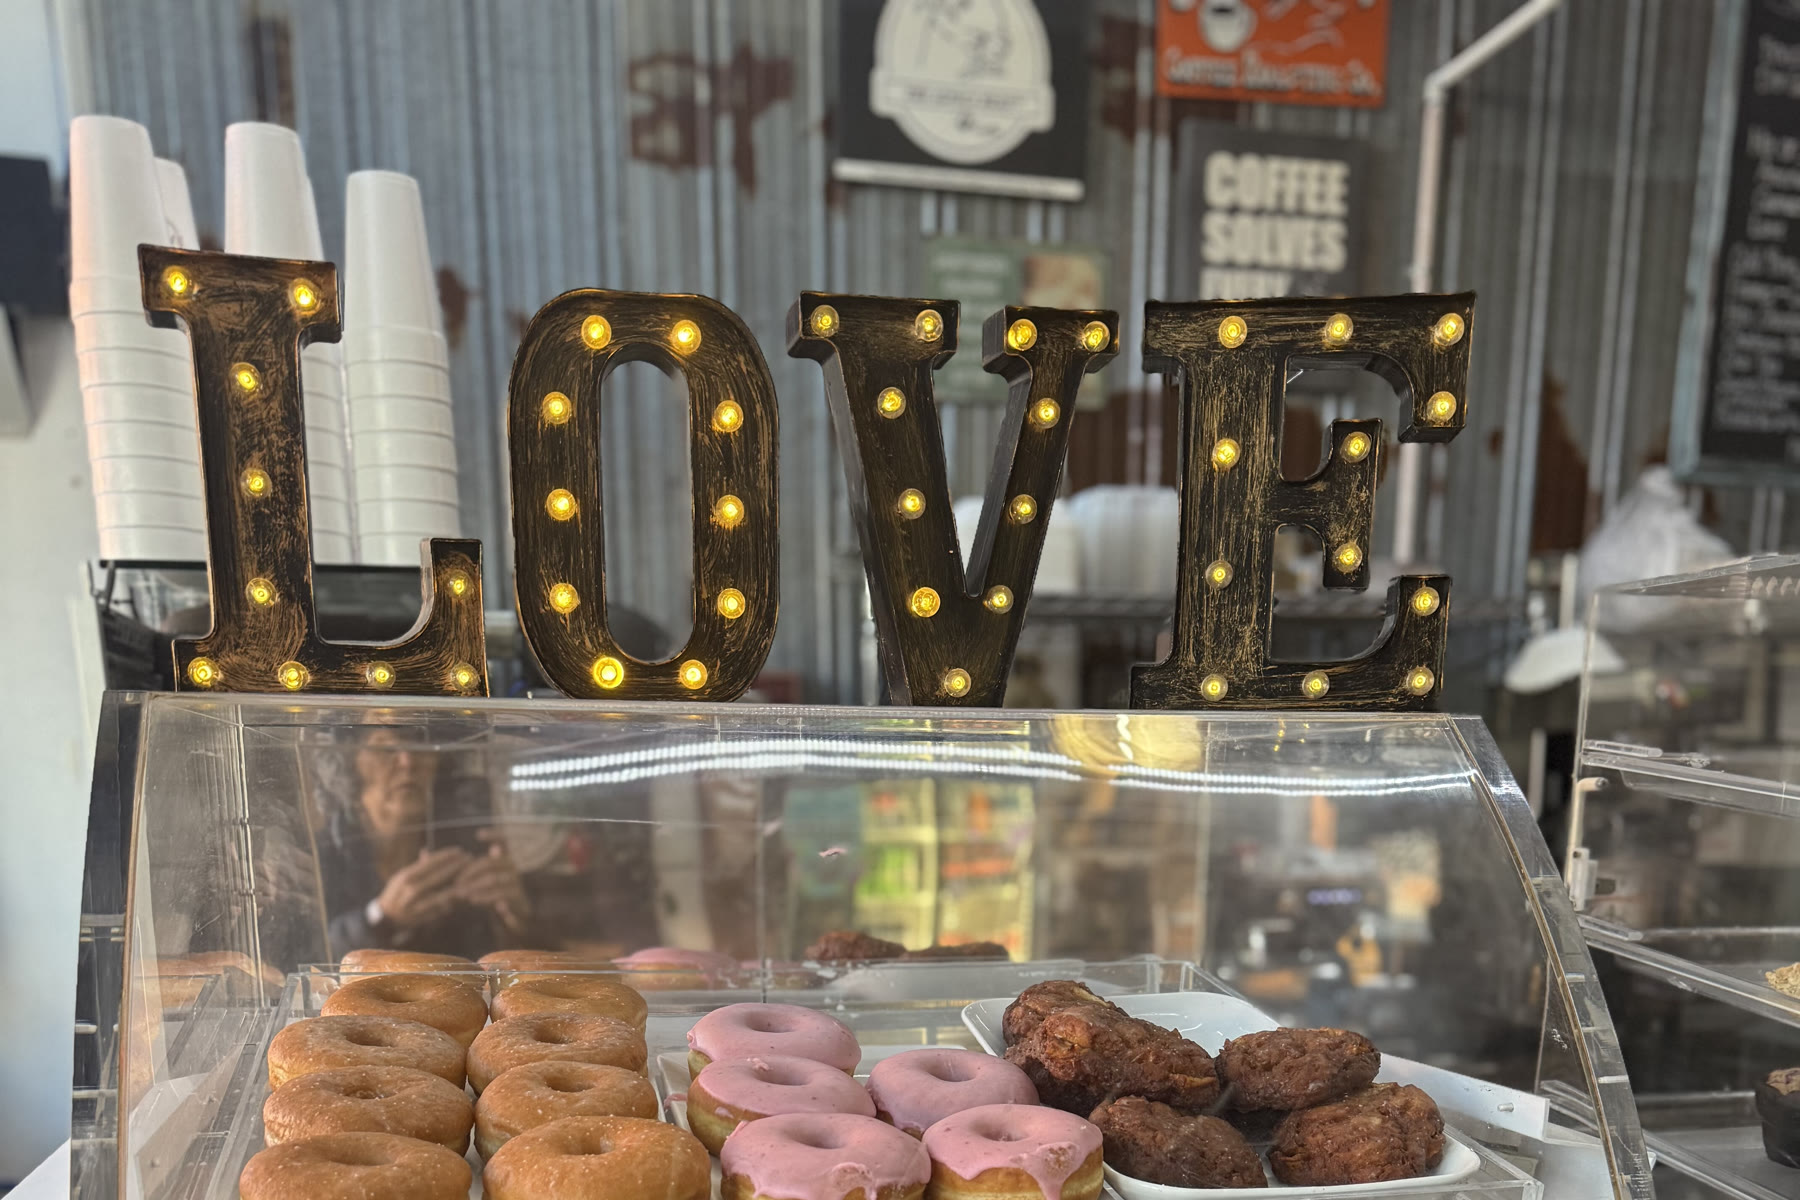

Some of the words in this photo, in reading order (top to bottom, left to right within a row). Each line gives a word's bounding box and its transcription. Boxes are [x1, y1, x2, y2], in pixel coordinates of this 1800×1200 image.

[1204, 151, 1349, 216] COFFEE
[1201, 210, 1347, 273] SOLVES
[138, 243, 1476, 709] LOVE
